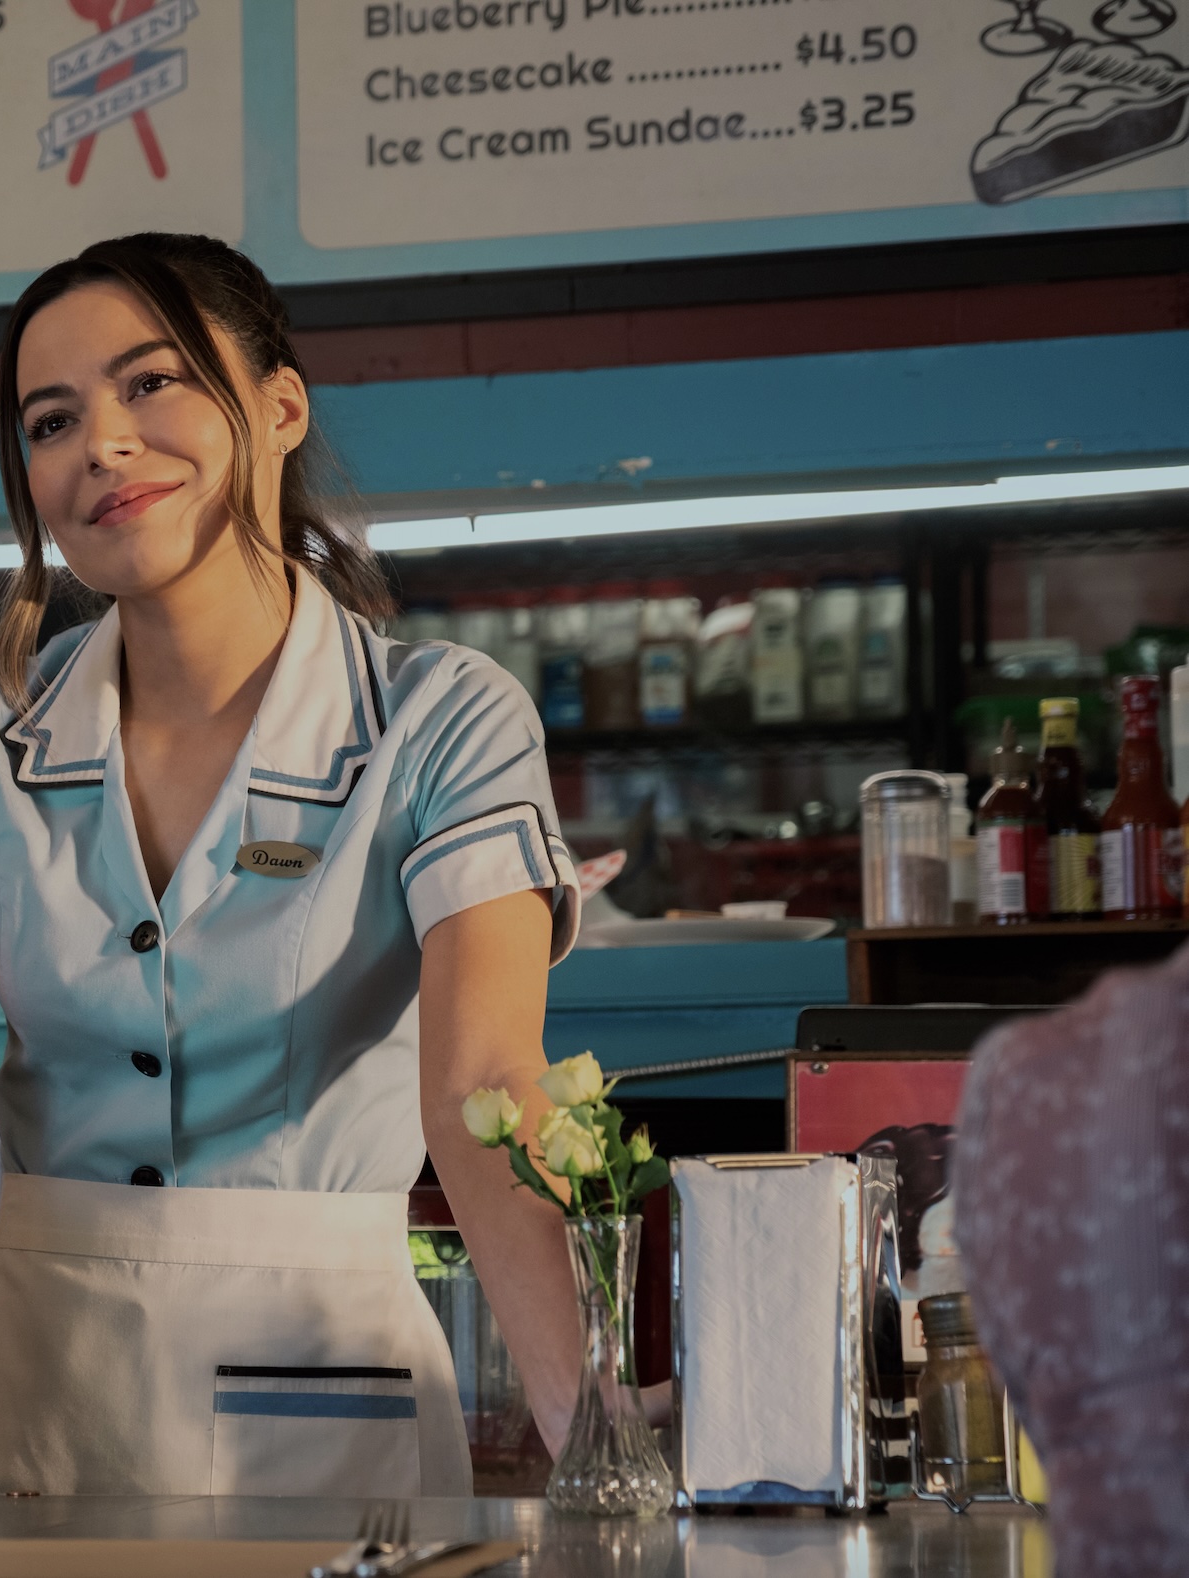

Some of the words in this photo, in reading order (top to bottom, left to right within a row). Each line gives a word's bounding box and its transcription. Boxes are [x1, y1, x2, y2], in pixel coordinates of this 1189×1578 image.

[58, 10, 175, 81] MAIN
[365, 0, 566, 37] Blueberry
[366, 52, 612, 101] Cheesecake
[796, 24, 917, 66] $4.50
[66, 67, 169, 136] DISH
[367, 135, 423, 167] Ice
[439, 128, 568, 161] Cream
[586, 107, 746, 150] Sundae
[799, 91, 916, 132] $3.25
[252, 849, 305, 868] Dawn
